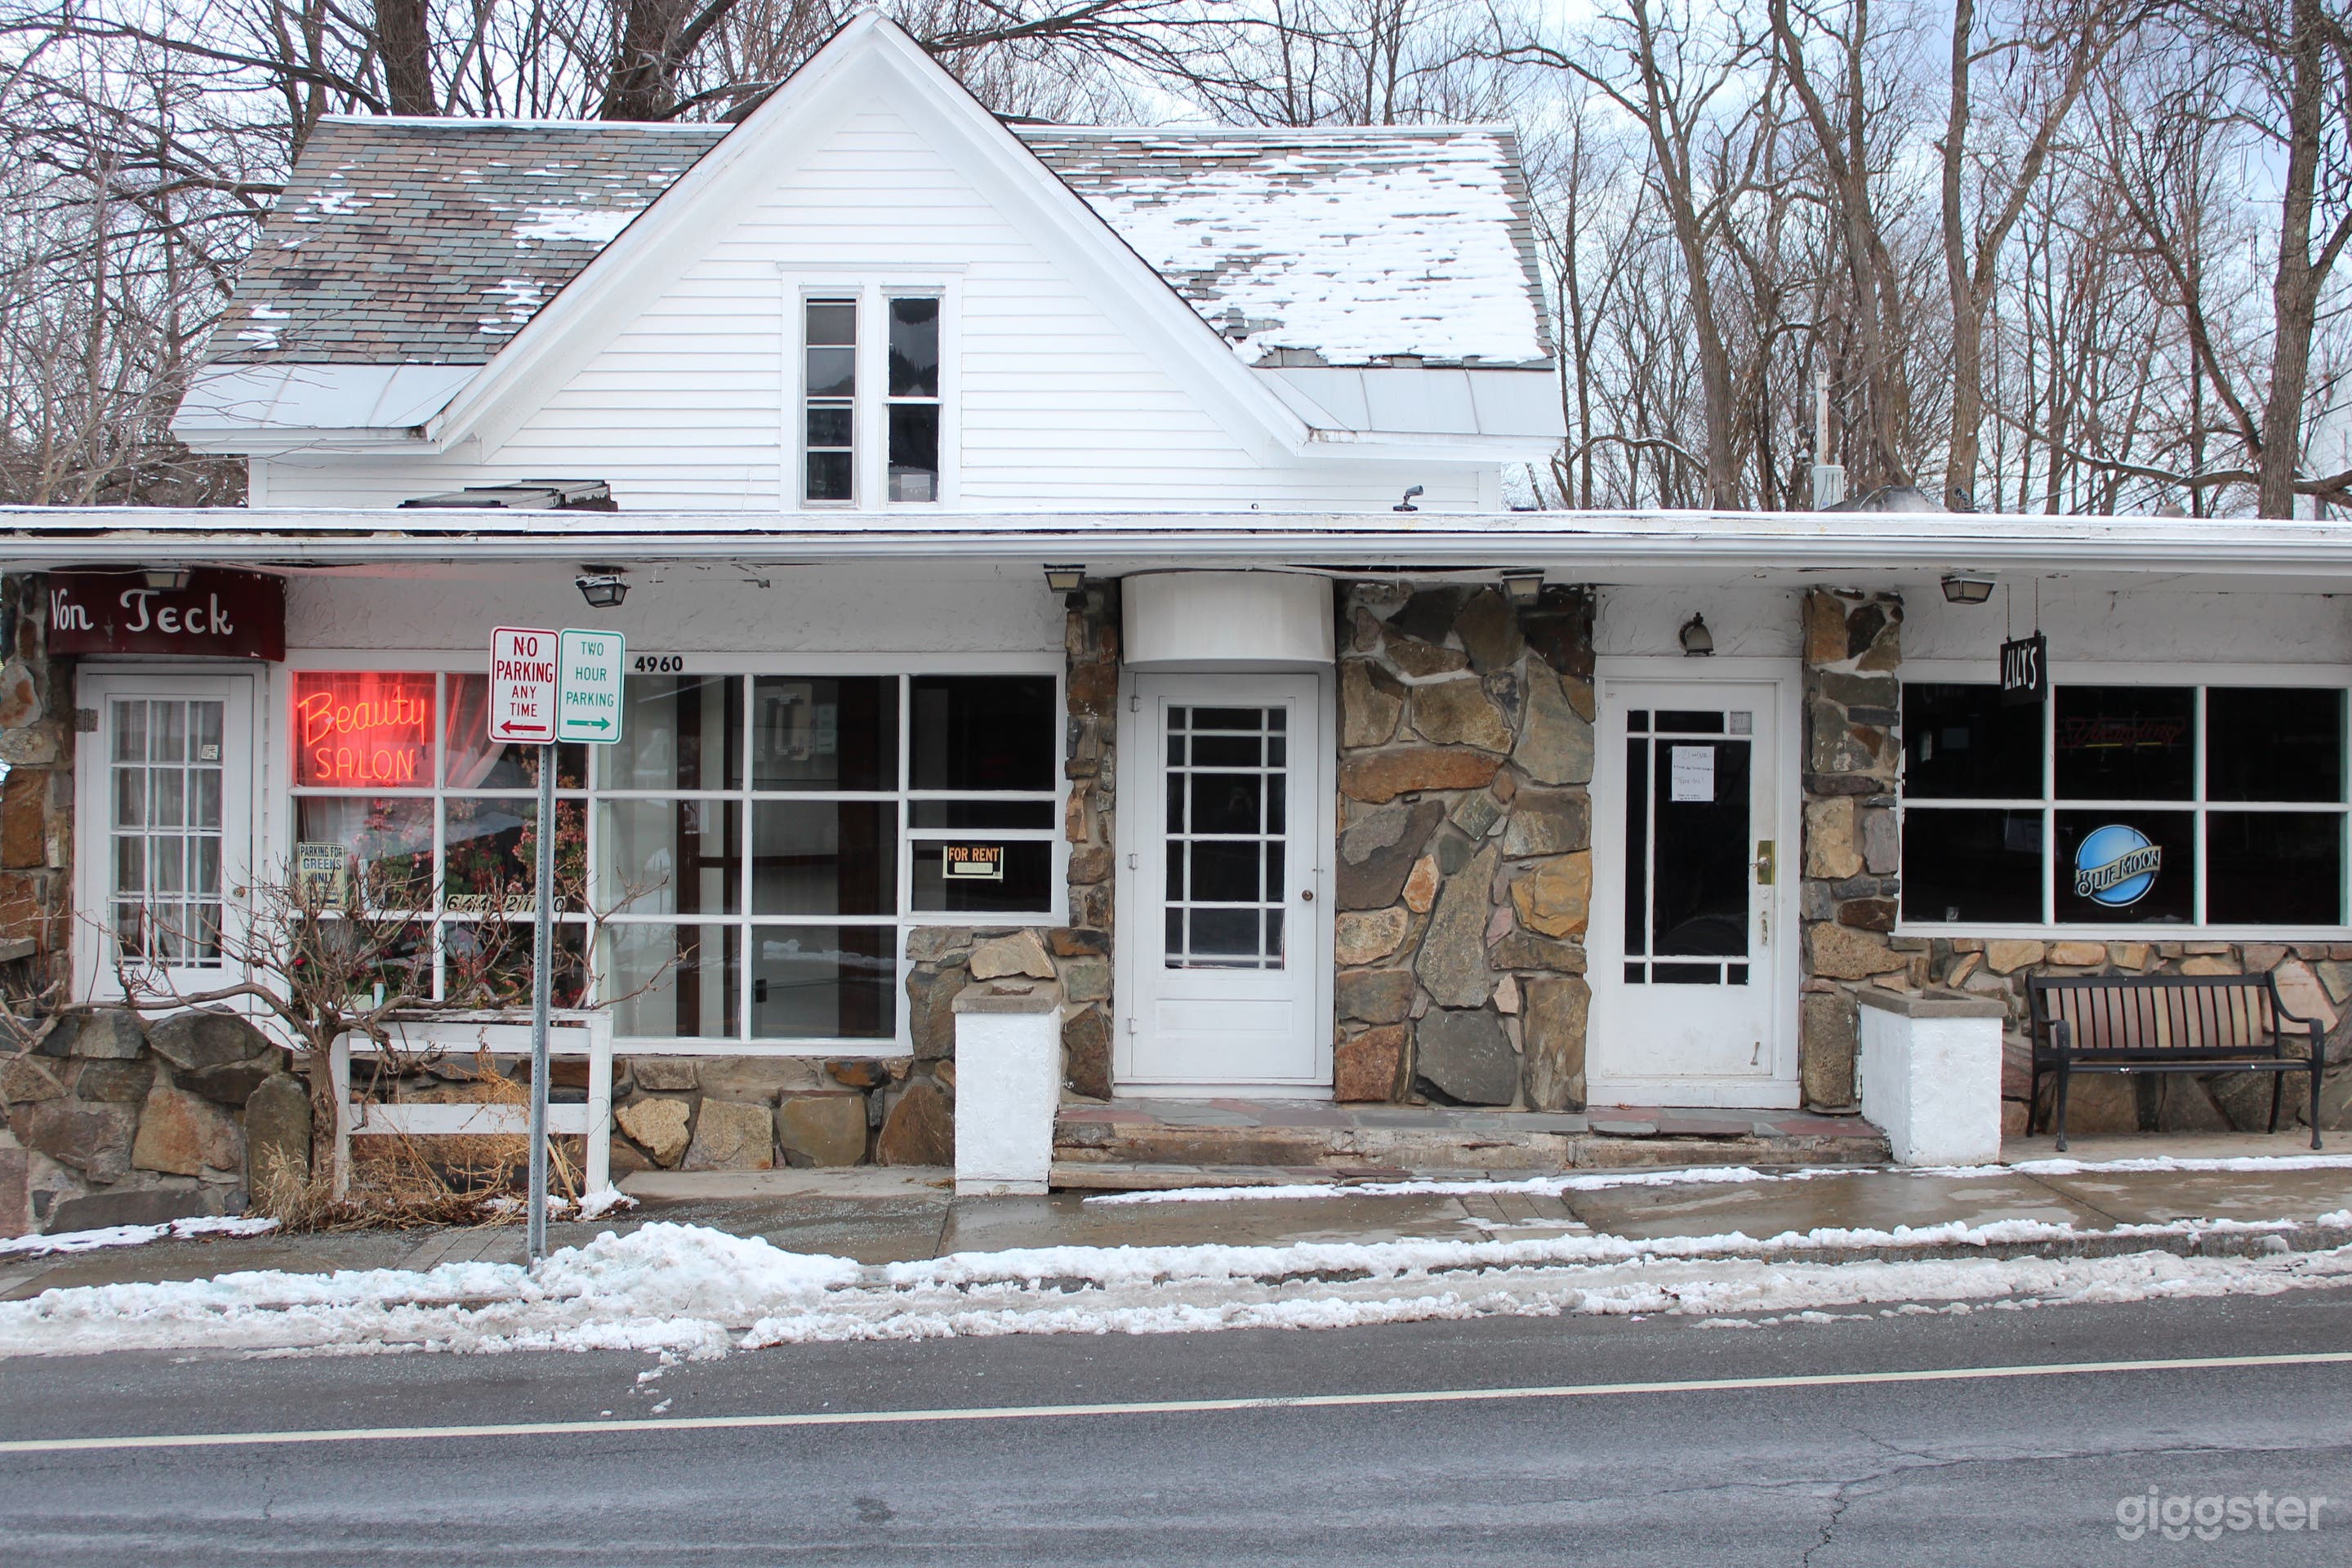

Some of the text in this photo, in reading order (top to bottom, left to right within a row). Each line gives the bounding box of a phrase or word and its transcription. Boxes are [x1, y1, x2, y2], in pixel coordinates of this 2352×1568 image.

[51, 588, 234, 635] Von Teck
[513, 636, 538, 657] NO
[581, 641, 604, 657] TWO
[497, 660, 554, 684] PARKING
[635, 656, 684, 672] 4960
[575, 666, 607, 682] HOUR
[511, 685, 537, 699] ANY
[566, 691, 614, 707] PARKING
[297, 685, 425, 747] Beauty
[510, 702, 537, 717] TIME
[315, 747, 415, 780] SALON
[301, 845, 343, 858] PARKING FOR
[948, 847, 999, 862] FOR RENT
